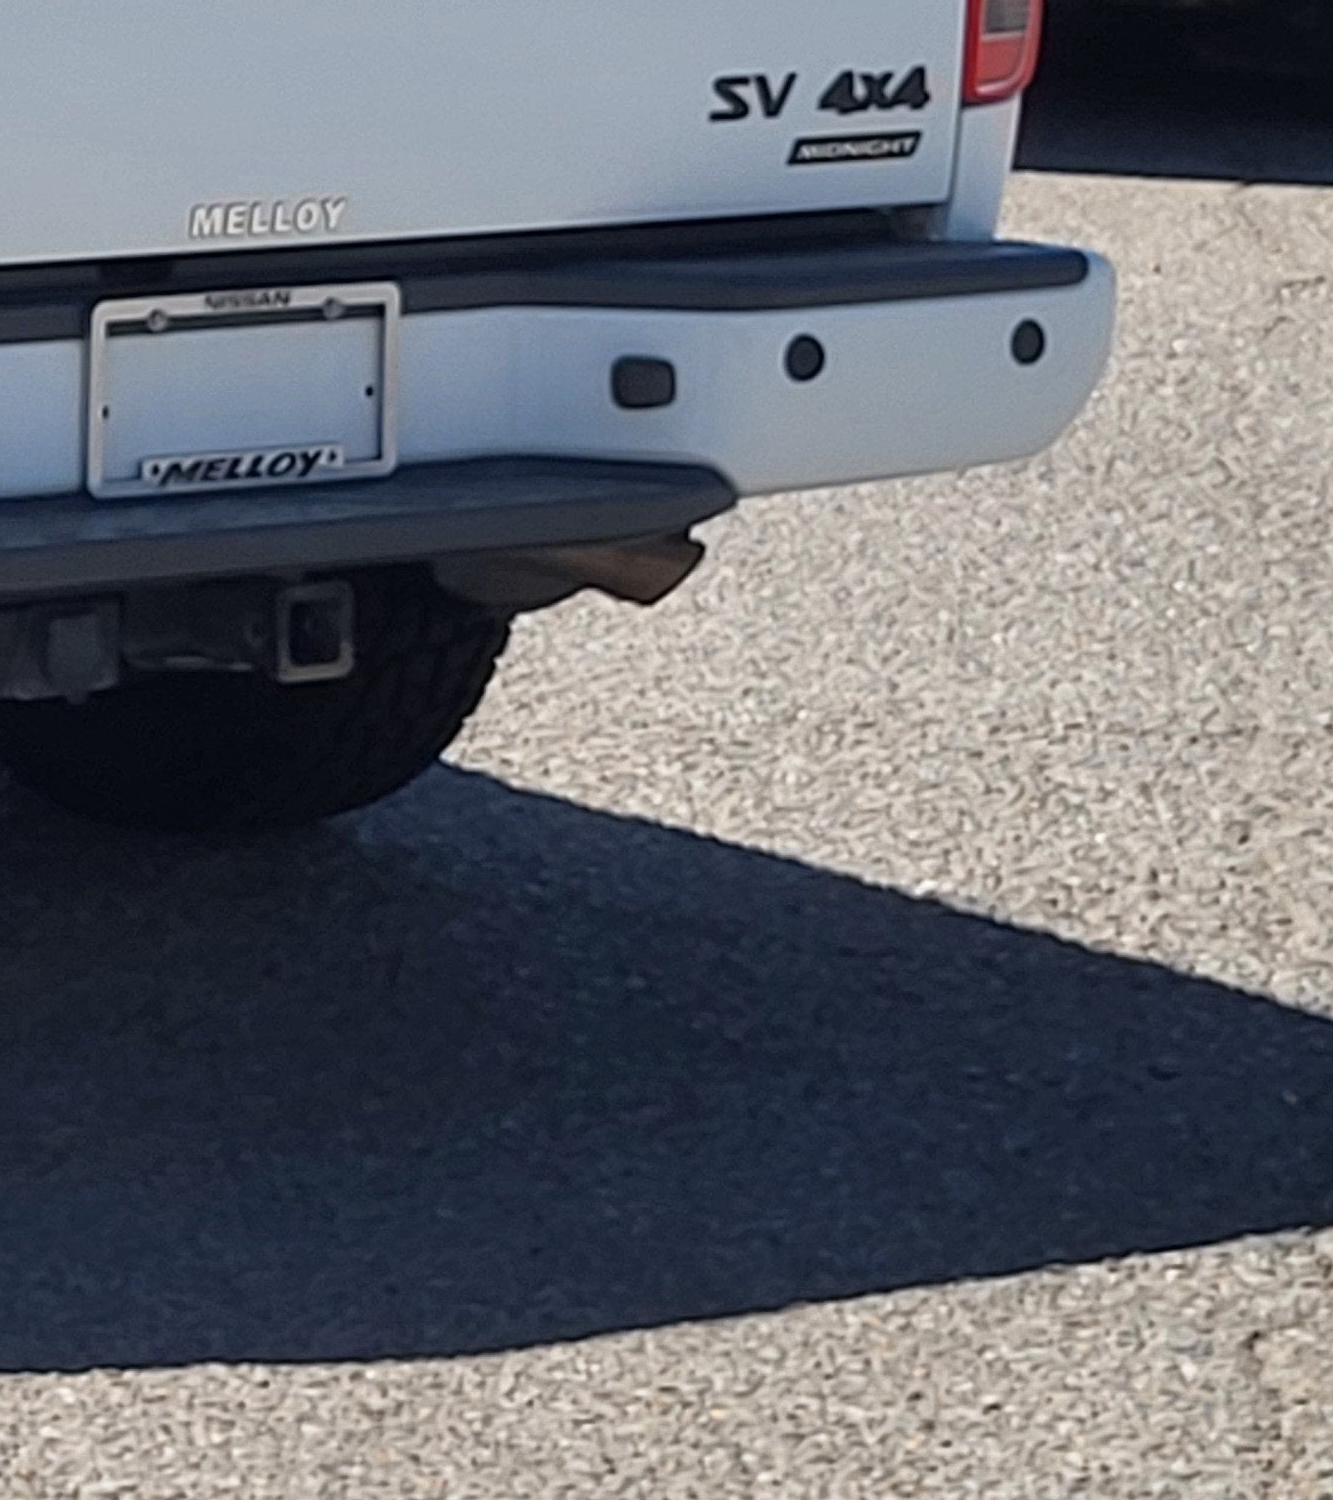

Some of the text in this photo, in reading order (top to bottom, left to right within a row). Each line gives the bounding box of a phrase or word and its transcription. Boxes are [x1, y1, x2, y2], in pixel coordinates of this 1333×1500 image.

[708, 72, 797, 122] SV
[797, 137, 914, 160] MIDNIGHT
[189, 196, 347, 239] MELLOY
[204, 290, 292, 310] NISSAN
[159, 448, 325, 487] MELLOY
